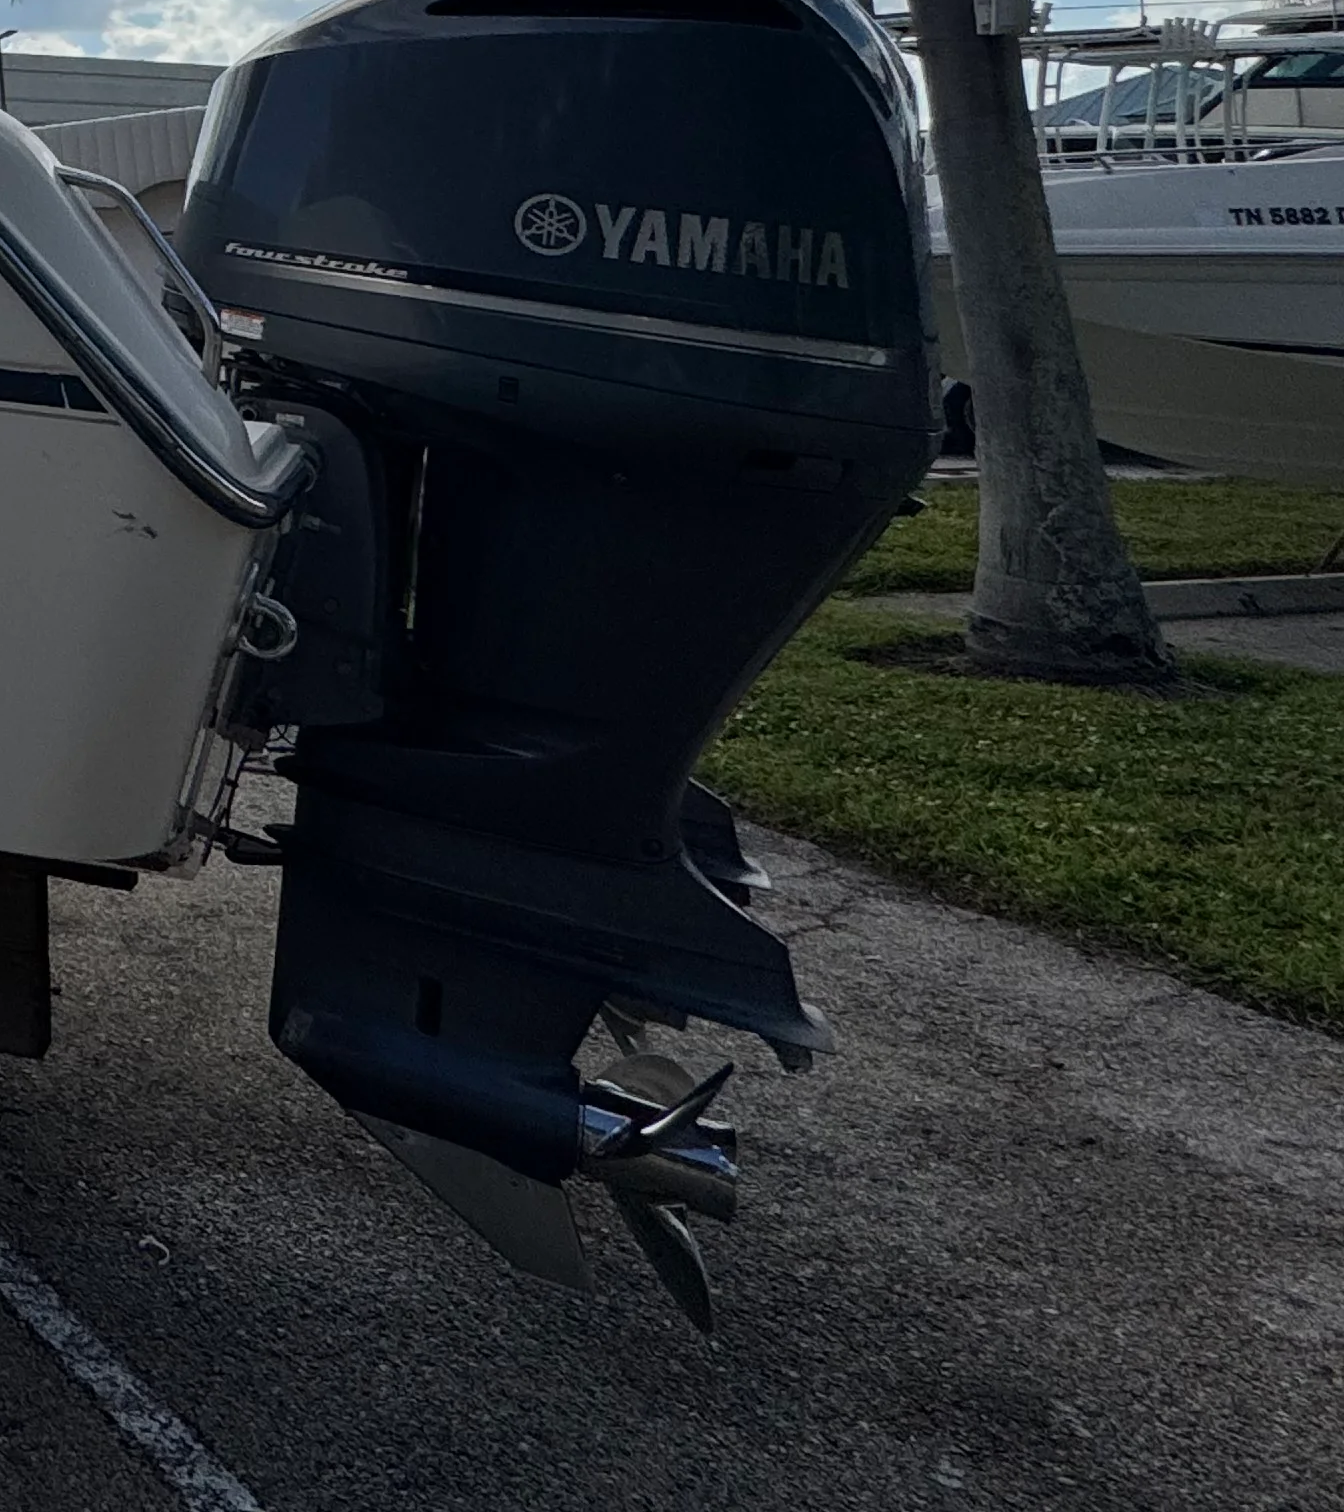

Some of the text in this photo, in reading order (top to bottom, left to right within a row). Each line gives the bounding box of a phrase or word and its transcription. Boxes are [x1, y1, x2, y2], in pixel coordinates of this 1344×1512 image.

[1228, 207, 1265, 225] TN
[224, 242, 409, 280] fourstroke
[594, 203, 849, 289] YAMAHA
